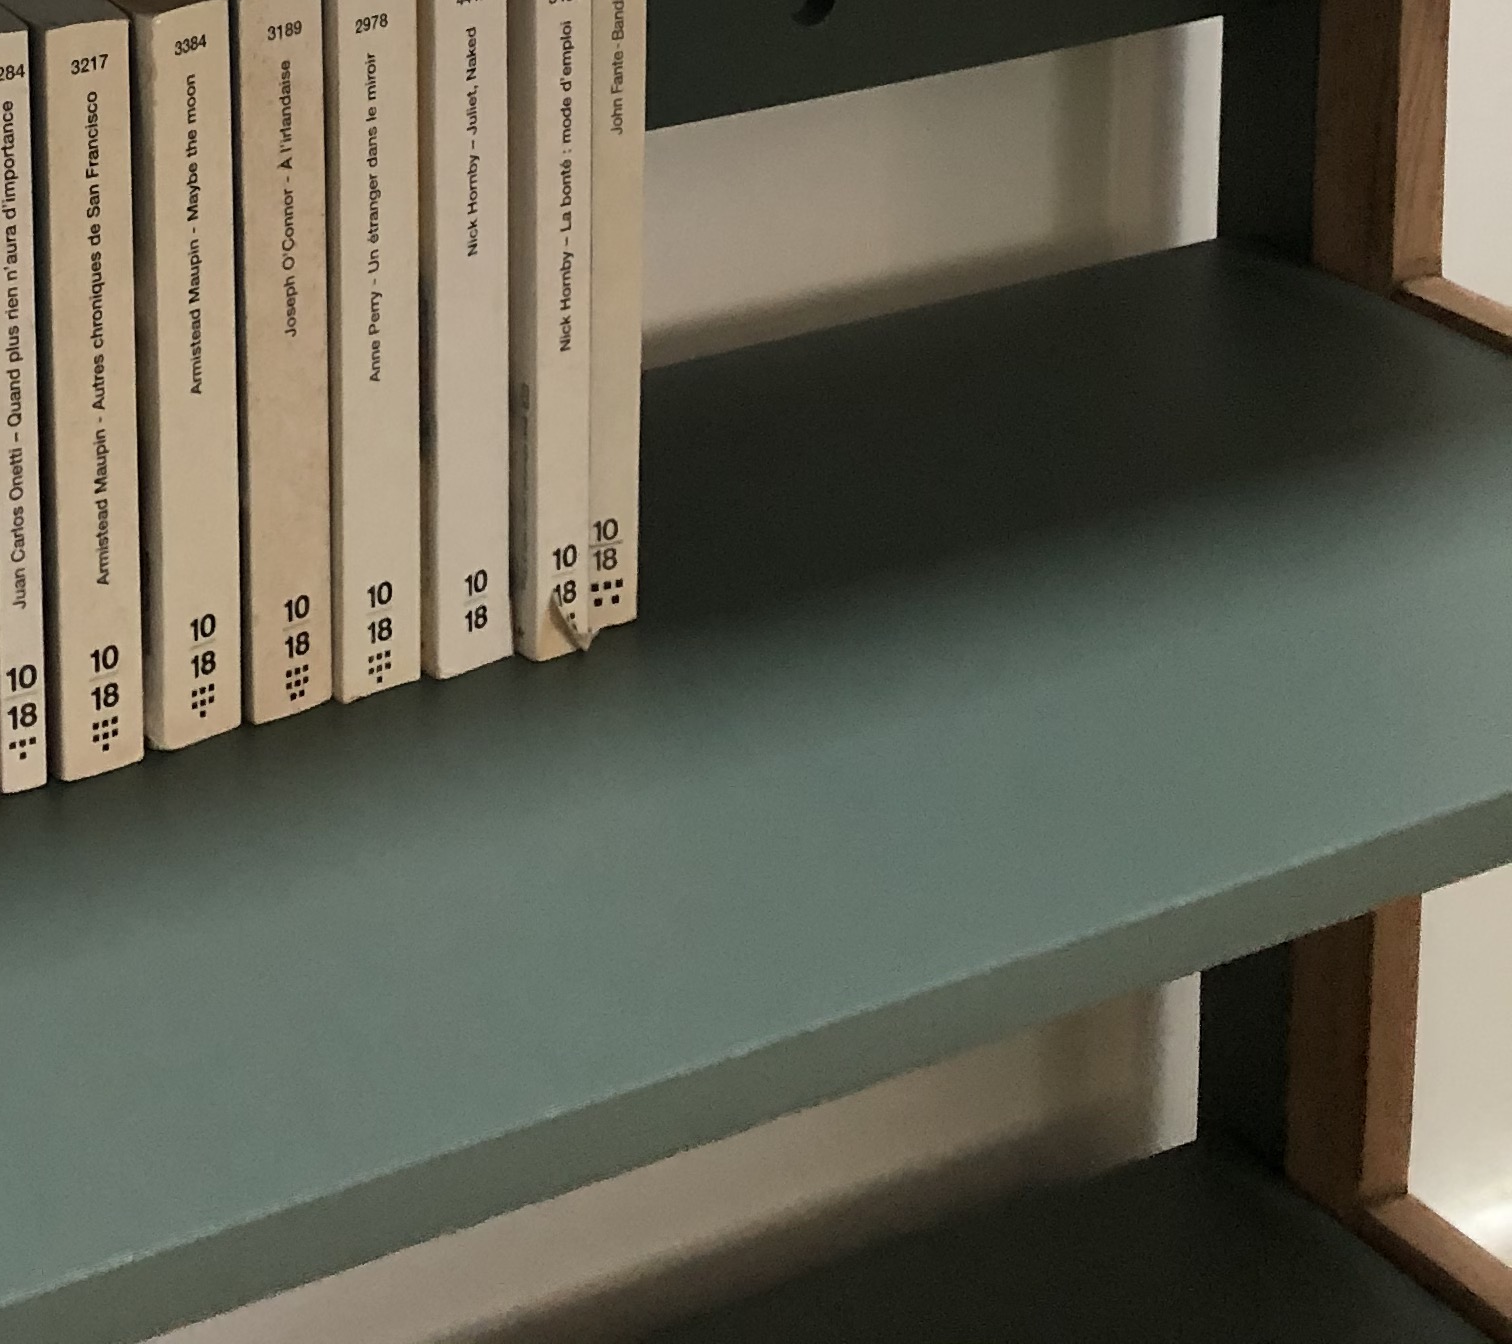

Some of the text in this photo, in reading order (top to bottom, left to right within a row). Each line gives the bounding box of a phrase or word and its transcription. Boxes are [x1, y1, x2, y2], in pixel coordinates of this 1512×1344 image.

[267, 19, 303, 41] 3189
[355, 12, 389, 35] 2978
[70, 53, 109, 76] 3217
[174, 33, 207, 56] 3384
[464, 26, 477, 83] Naked
[559, 20, 575, 93] d'emploi
[364, 52, 377, 102] miroir
[185, 73, 197, 125] moon
[278, 59, 293, 155] l'irlandaise
[364, 106, 377, 123] le
[465, 84, 479, 136] Juliet,
[609, 97, 624, 137] John
[84, 91, 100, 180] Francisco
[559, 96, 572, 145] mode
[0, 100, 19, 221] d'importance
[184, 129, 198, 159] the
[276, 156, 293, 171] À
[365, 125, 378, 169] dans
[85, 183, 101, 219] San
[185, 161, 201, 223] Maybe
[466, 154, 481, 216] Hornby
[558, 159, 572, 209] bonté
[366, 173, 382, 245] étranger
[559, 210, 572, 233] La
[86, 223, 102, 247] de
[280, 188, 296, 271] O'Connor
[466, 218, 479, 258] Nick
[2, 224, 18, 282] n'aura
[187, 238, 203, 305] Maupin
[366, 248, 380, 275] Un
[88, 251, 106, 350] chroniques
[559, 251, 575, 312] Hornby
[4, 286, 19, 321] rien
[282, 275, 298, 339] Joseph
[367, 291, 383, 337] Perry
[4, 325, 24, 364] plus
[188, 308, 202, 395] Armistead
[558, 315, 572, 353] Nick
[368, 339, 381, 383] Anne
[5, 368, 22, 429] Quand
[91, 353, 106, 411] Autres
[8, 447, 24, 502] Onetti
[92, 428, 110, 495] Maupin
[9, 505, 26, 564] Carlos
[94, 498, 110, 586] Armistead
[592, 517, 619, 543] 10
[552, 543, 578, 571] 10
[592, 547, 619, 572] 18
[11, 567, 27, 611] Juan
[367, 580, 393, 609] 10
[464, 568, 488, 597] 10
[552, 579, 577, 608] 18
[189, 613, 217, 642] 10
[284, 594, 310, 623] 10
[464, 604, 488, 633] 18
[284, 630, 310, 659] 18
[367, 616, 393, 645] 18
[5, 664, 38, 693] 10
[90, 644, 120, 674] 10
[190, 650, 217, 679] 18
[7, 702, 38, 731] 18
[90, 682, 120, 711] 18
